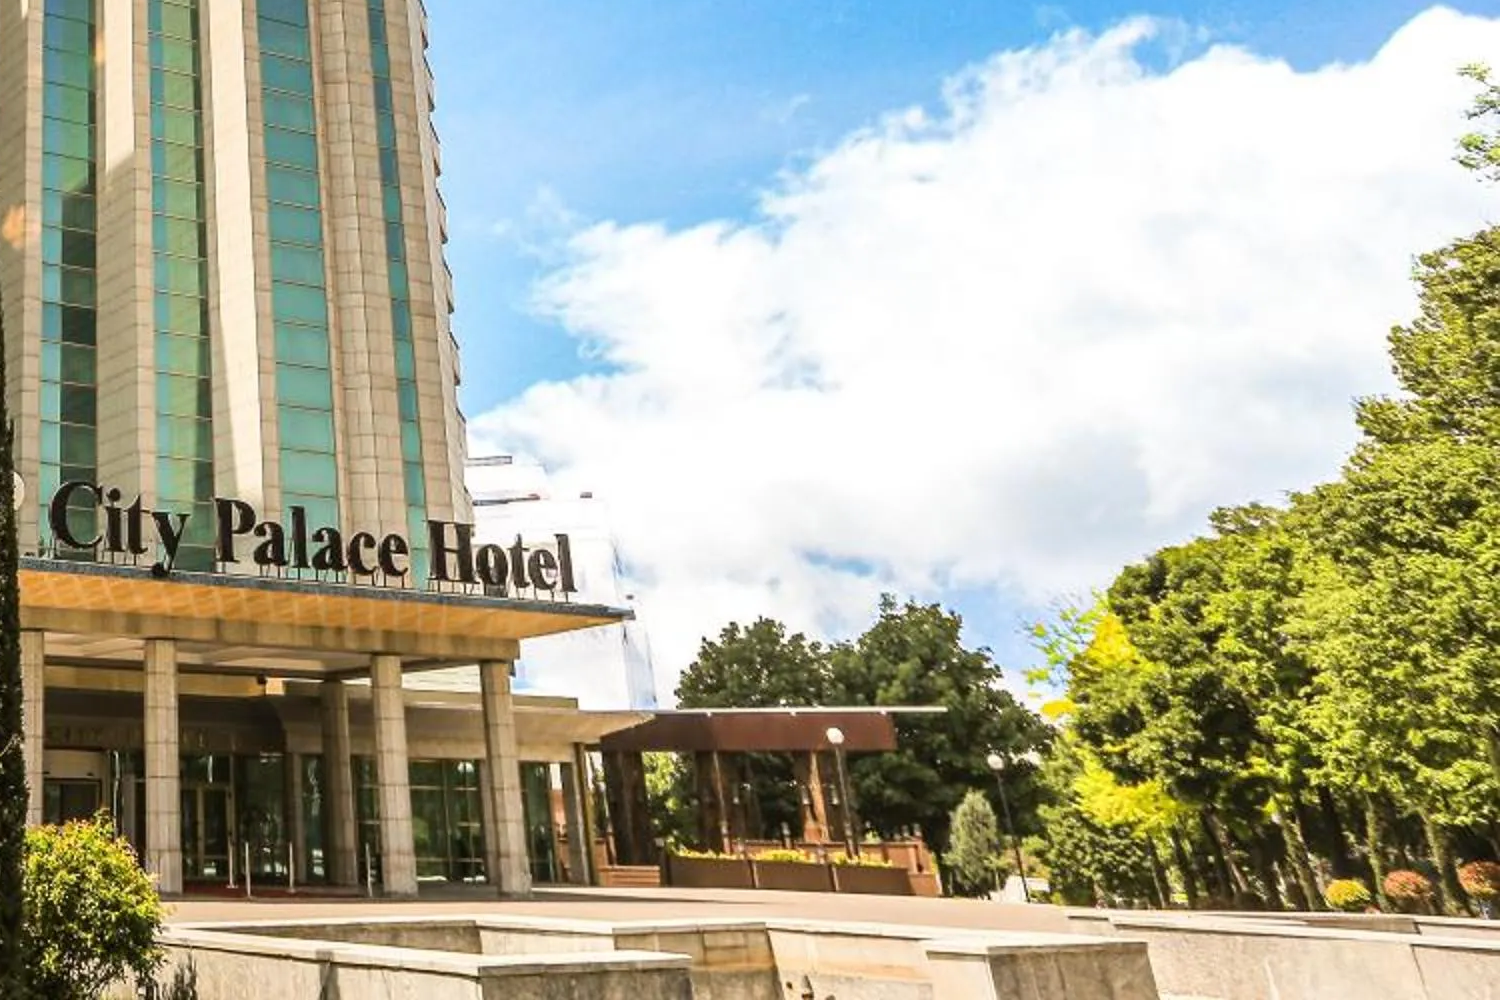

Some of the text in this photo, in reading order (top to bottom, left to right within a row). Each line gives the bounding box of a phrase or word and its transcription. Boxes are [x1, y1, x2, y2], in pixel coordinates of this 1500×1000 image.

[50, 481, 578, 592] City Palace Hotel
